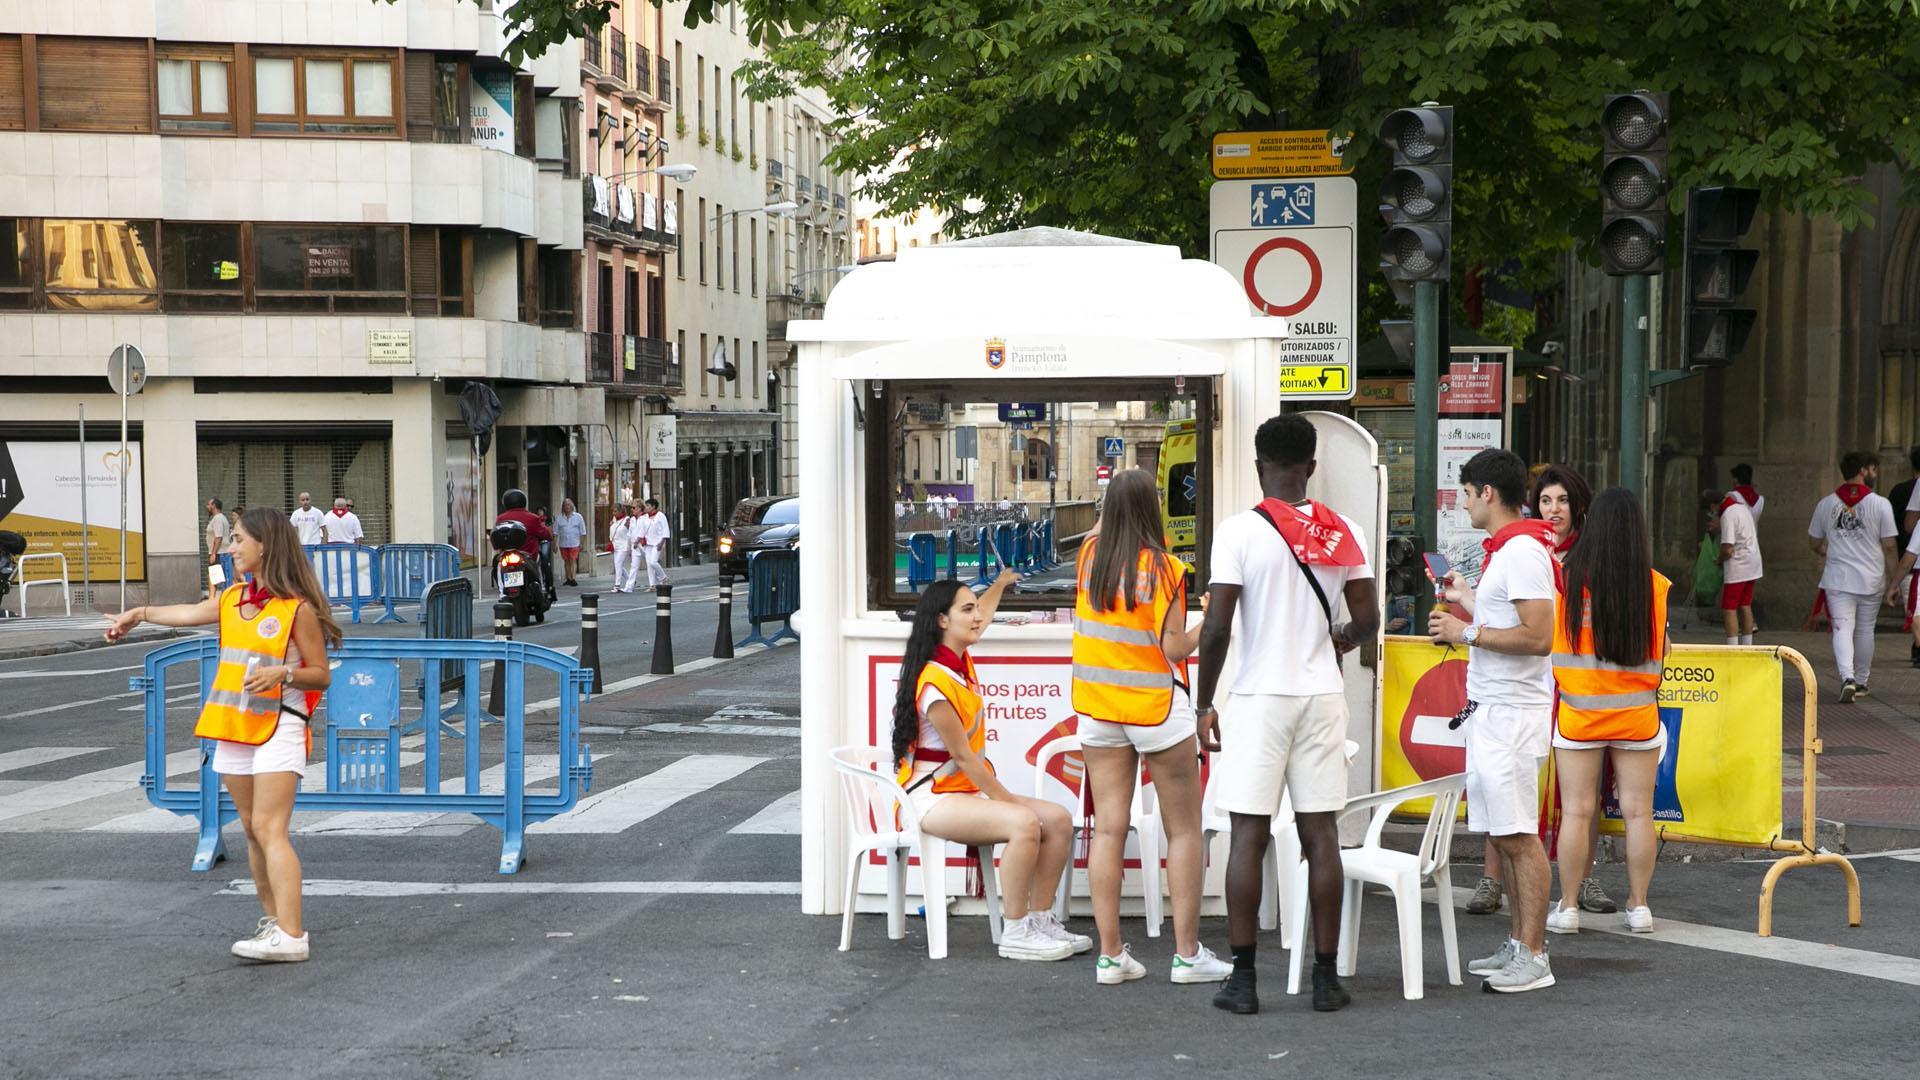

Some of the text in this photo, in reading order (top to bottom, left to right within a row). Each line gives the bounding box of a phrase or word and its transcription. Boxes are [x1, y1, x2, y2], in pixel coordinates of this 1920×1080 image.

[471, 127, 497, 140] ANUR
[1284, 136, 1324, 144] CONTROLADO
[1218, 167, 1246, 175] DENUNCIA
[1284, 165, 1312, 173] SALAKETA
[1294, 322, 1337, 335] SALBU:
[1281, 342, 1335, 352] UTORIZADOS
[1011, 352, 1067, 365] Pamplona
[1280, 379, 1317, 389] KOITIAK)
[1464, 431, 1492, 440] IGNACIO
[1167, 519, 1197, 529] AMBU
[1663, 666, 1715, 683] cceso
[1014, 683, 1062, 701] para
[1657, 687, 1719, 703] sartzeko
[984, 702, 1047, 720] frutes
